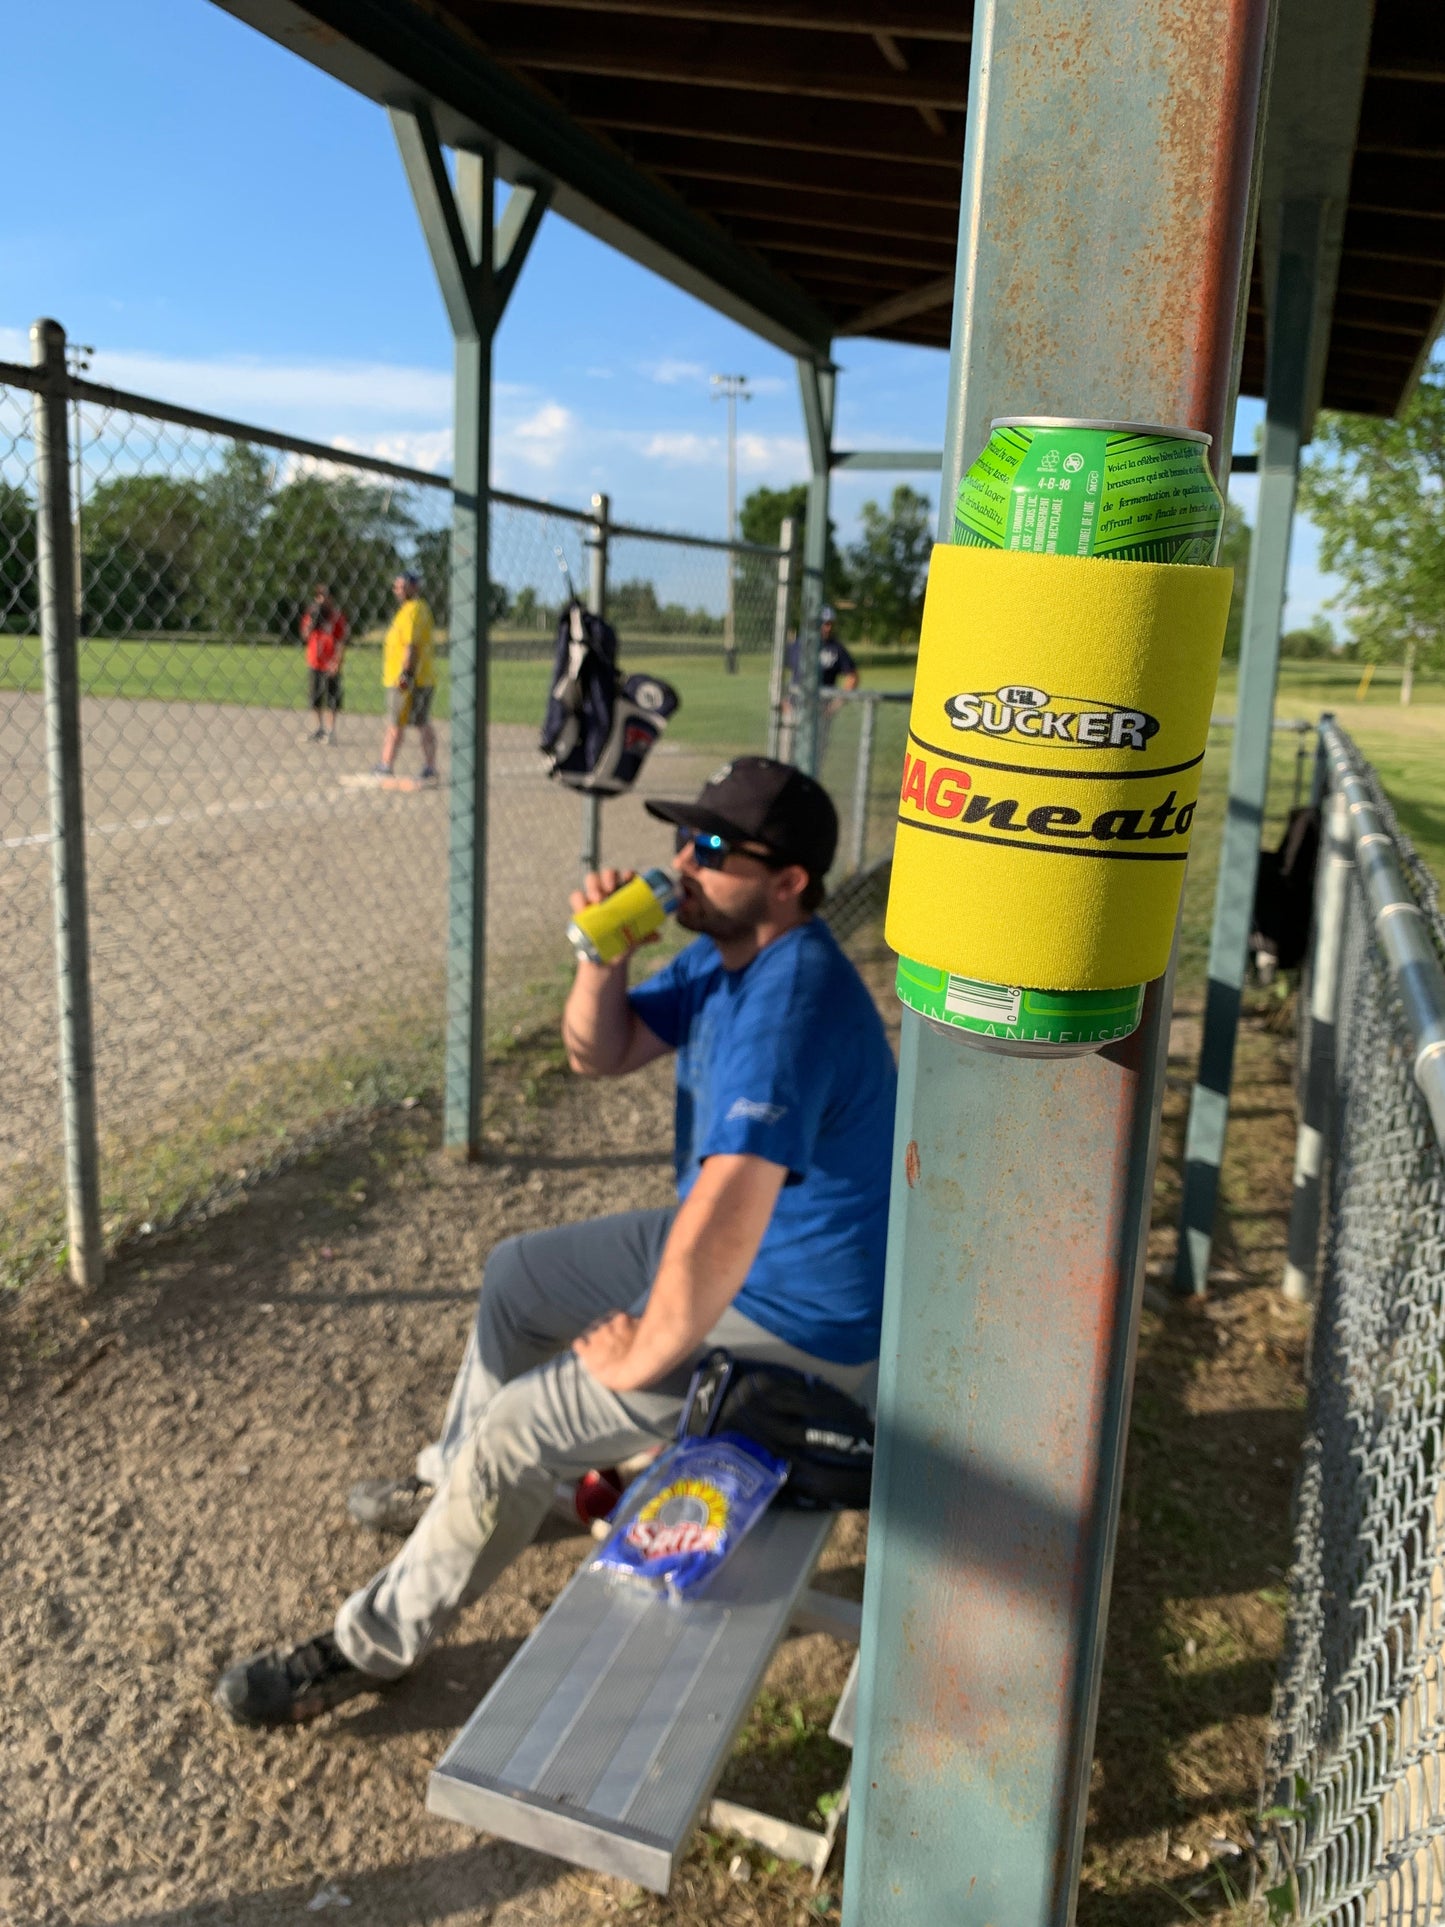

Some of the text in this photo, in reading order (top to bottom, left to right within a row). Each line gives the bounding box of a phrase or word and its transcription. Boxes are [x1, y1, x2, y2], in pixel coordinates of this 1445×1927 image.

[1108, 463, 1127, 473] Voici
[1128, 460, 1136, 468] la
[1089, 472, 1099, 492] MCC
[1106, 475, 1146, 491] brasseurs
[1146, 472, 1158, 485] qui
[985, 484, 1005, 504] lager
[1103, 502, 1113, 512] de
[1118, 490, 1171, 510] fermentation
[1048, 498, 1063, 539] RECYCLABLE
[1083, 501, 1095, 516] LIME
[1081, 517, 1093, 525] DE
[1100, 515, 1133, 533] offrant
[1137, 513, 1153, 523] une
[951, 693, 1147, 750] SUCKER
[902, 752, 1198, 841] AGneato
